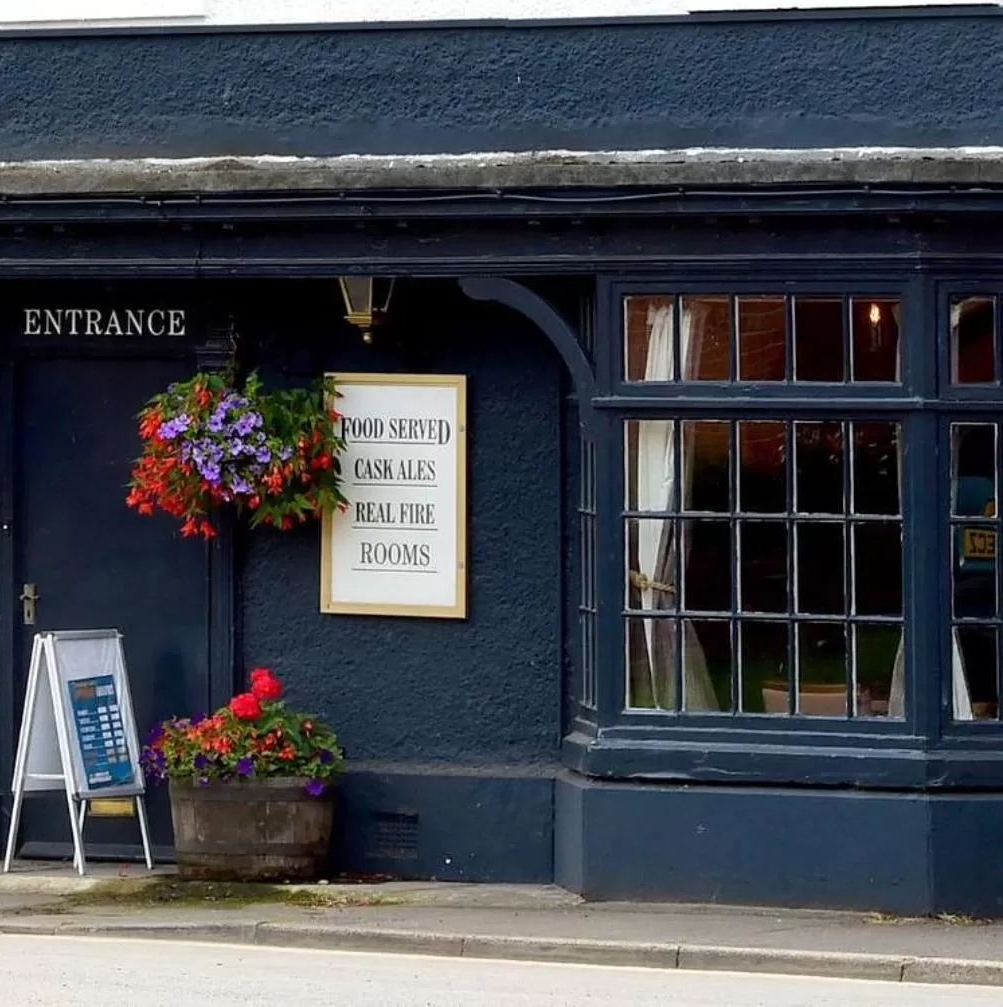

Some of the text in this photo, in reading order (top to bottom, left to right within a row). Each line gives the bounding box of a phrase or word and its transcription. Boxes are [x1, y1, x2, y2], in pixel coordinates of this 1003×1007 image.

[23, 308, 186, 336] ENTRANCE
[341, 417, 451, 445] FOOD SERVED
[354, 458, 436, 481] CASK ALES
[355, 502, 436, 525] REAL FIRE
[360, 542, 430, 567] ROOMS
